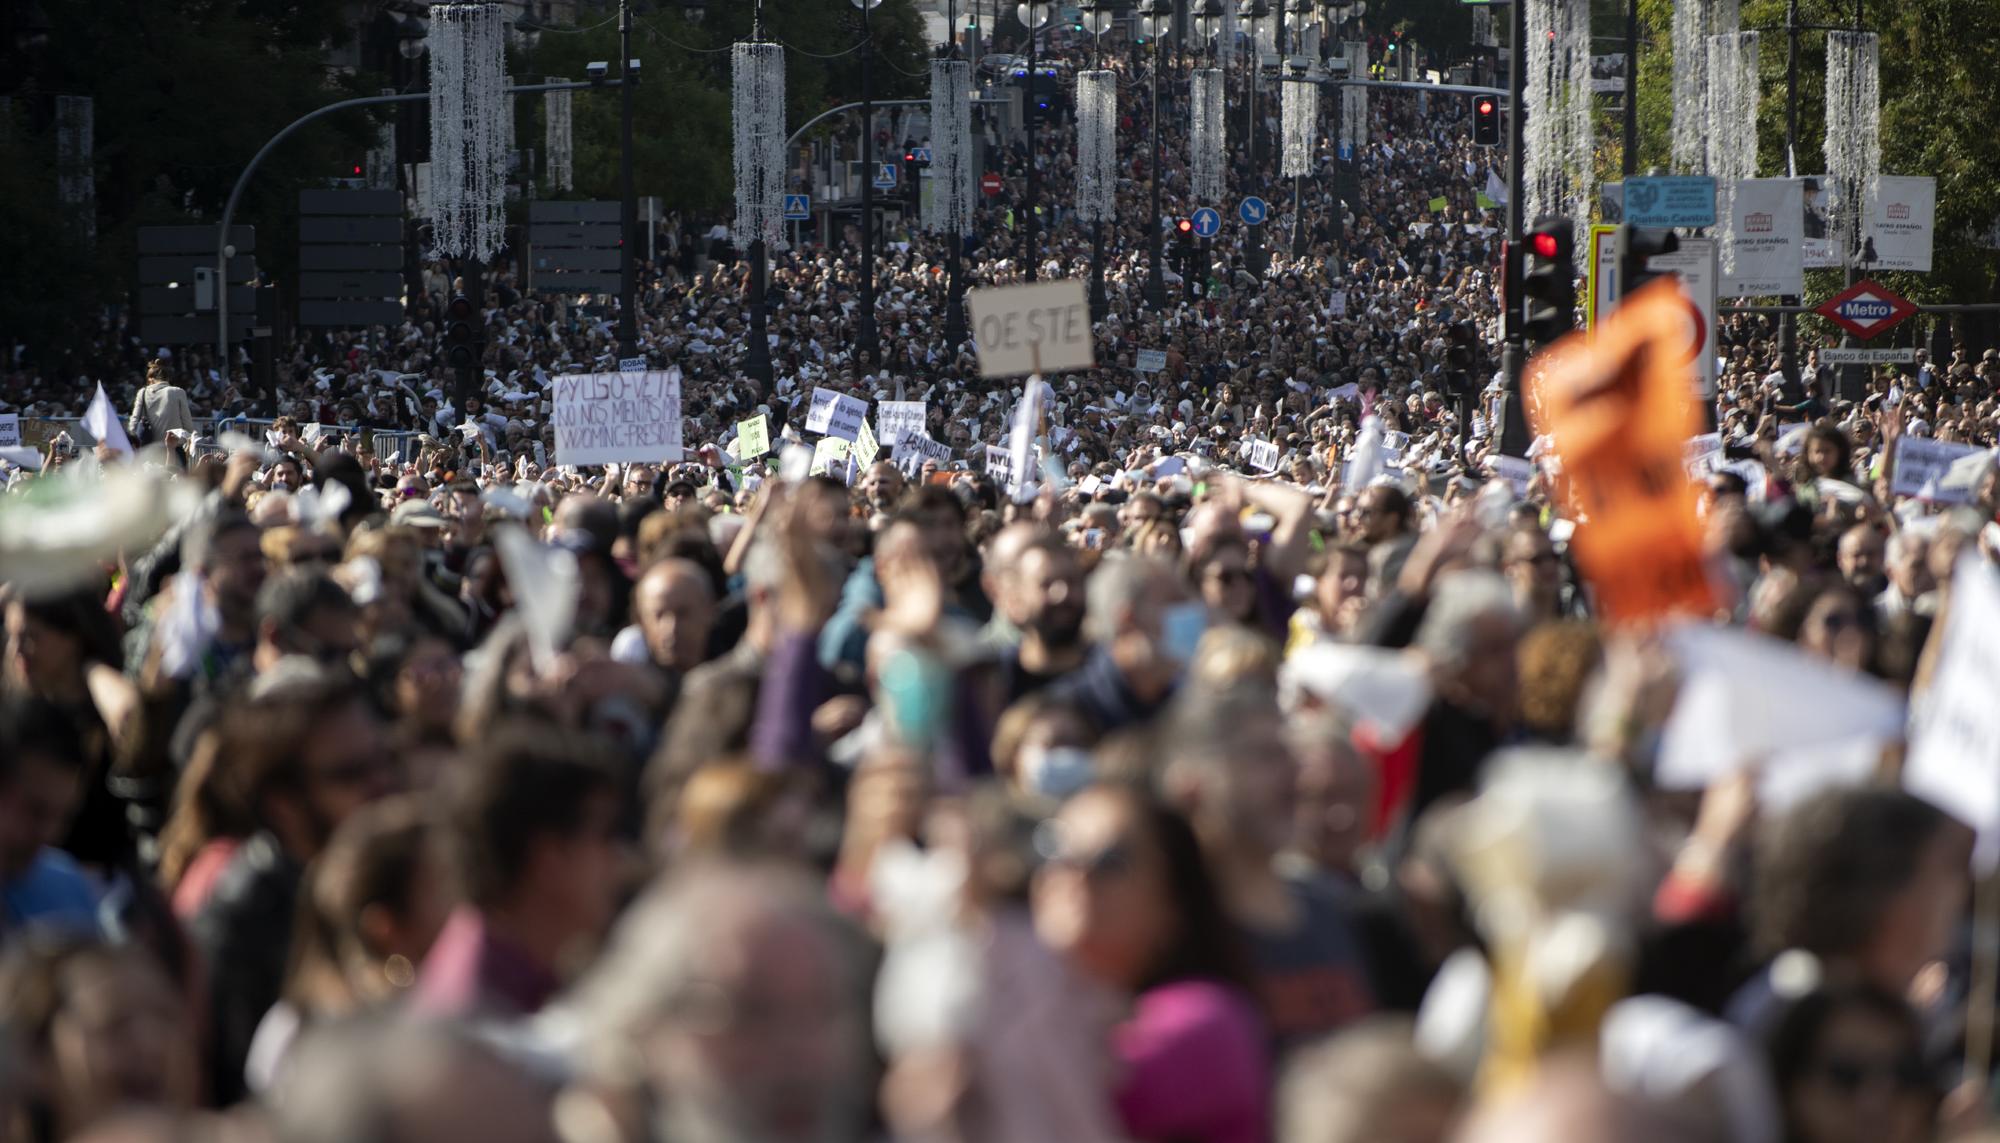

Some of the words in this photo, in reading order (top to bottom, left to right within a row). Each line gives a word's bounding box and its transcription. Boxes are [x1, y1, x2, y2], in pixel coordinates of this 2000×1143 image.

[1630, 214, 1670, 225] Distrito
[1671, 213, 1713, 223] Centro
[1756, 237, 1789, 245] ESPAÑOL
[1846, 303, 1888, 316] Metro
[1824, 351, 1856, 361] Banco
[1858, 351, 1870, 361] de
[1872, 351, 1910, 362] España
[913, 434, 949, 461] SANIDAD
